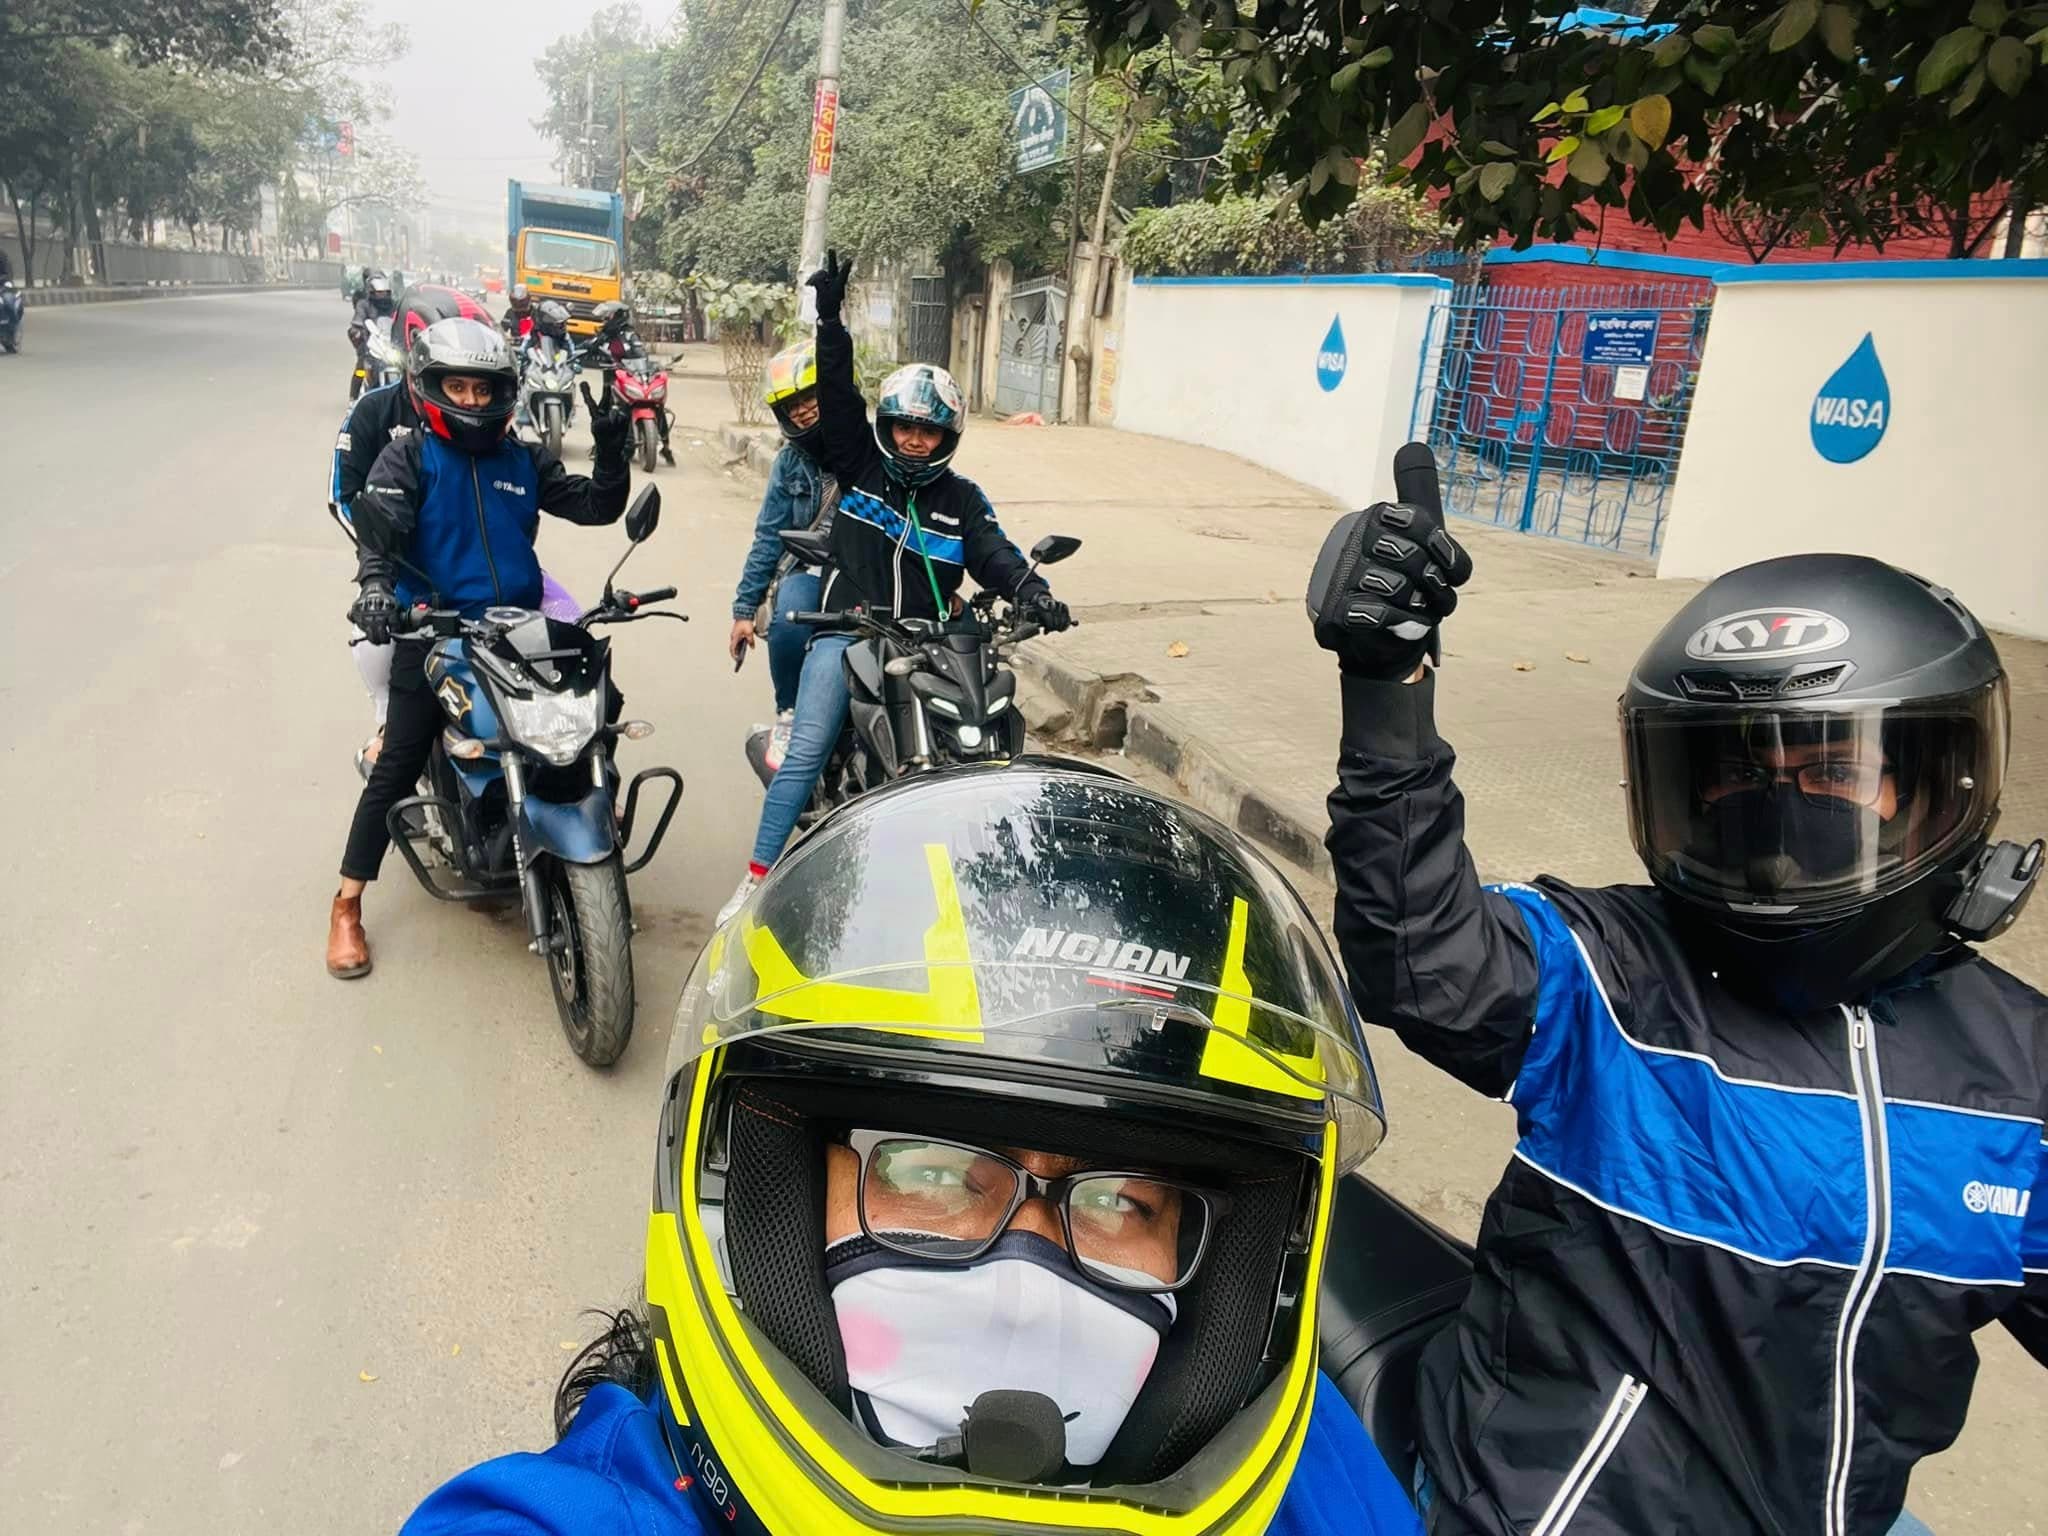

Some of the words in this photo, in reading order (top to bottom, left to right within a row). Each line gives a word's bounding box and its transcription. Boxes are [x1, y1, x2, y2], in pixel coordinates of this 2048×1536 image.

[1319, 352, 1345, 371] WASA
[1815, 397, 1884, 430] WASA
[1698, 616, 1832, 657] KYT
